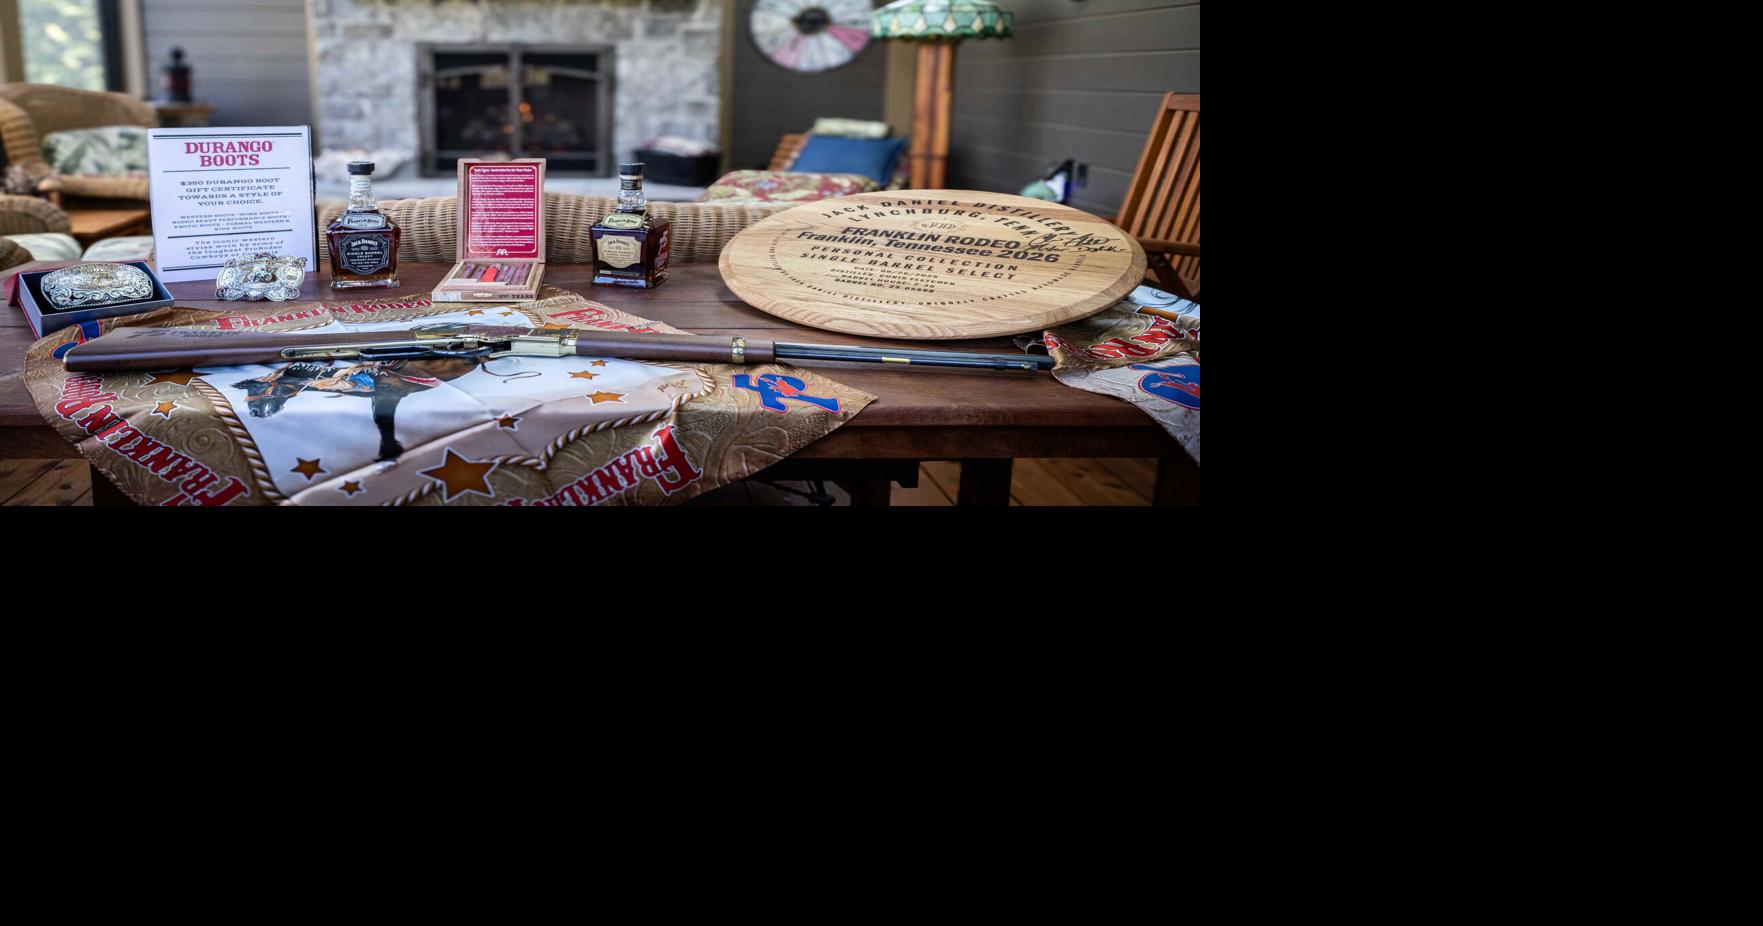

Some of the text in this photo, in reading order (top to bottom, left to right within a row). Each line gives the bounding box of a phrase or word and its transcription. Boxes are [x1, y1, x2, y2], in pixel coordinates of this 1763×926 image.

[184, 140, 273, 154] DURANGO
[200, 153, 260, 167] BOOTS
[211, 184, 275, 192] CERTIFICATE
[822, 204, 870, 219] JACK
[881, 199, 960, 207] DANIEL
[973, 202, 1077, 237] DISTILLERY
[848, 207, 1040, 238] LYNCHBURG, TENN.
[796, 231, 877, 247] Franklin,
[884, 238, 993, 257] Tennessee
[996, 250, 1061, 263] 2026
[841, 226, 942, 243] FRANKLIN
[944, 235, 1021, 250] RODEO
[799, 252, 1017, 280] SINGLE BARREL SELECT
[810, 245, 1019, 272] PERSONAL COLLECTION
[834, 278, 868, 286] BARREL
[350, 299, 433, 314] RODEO
